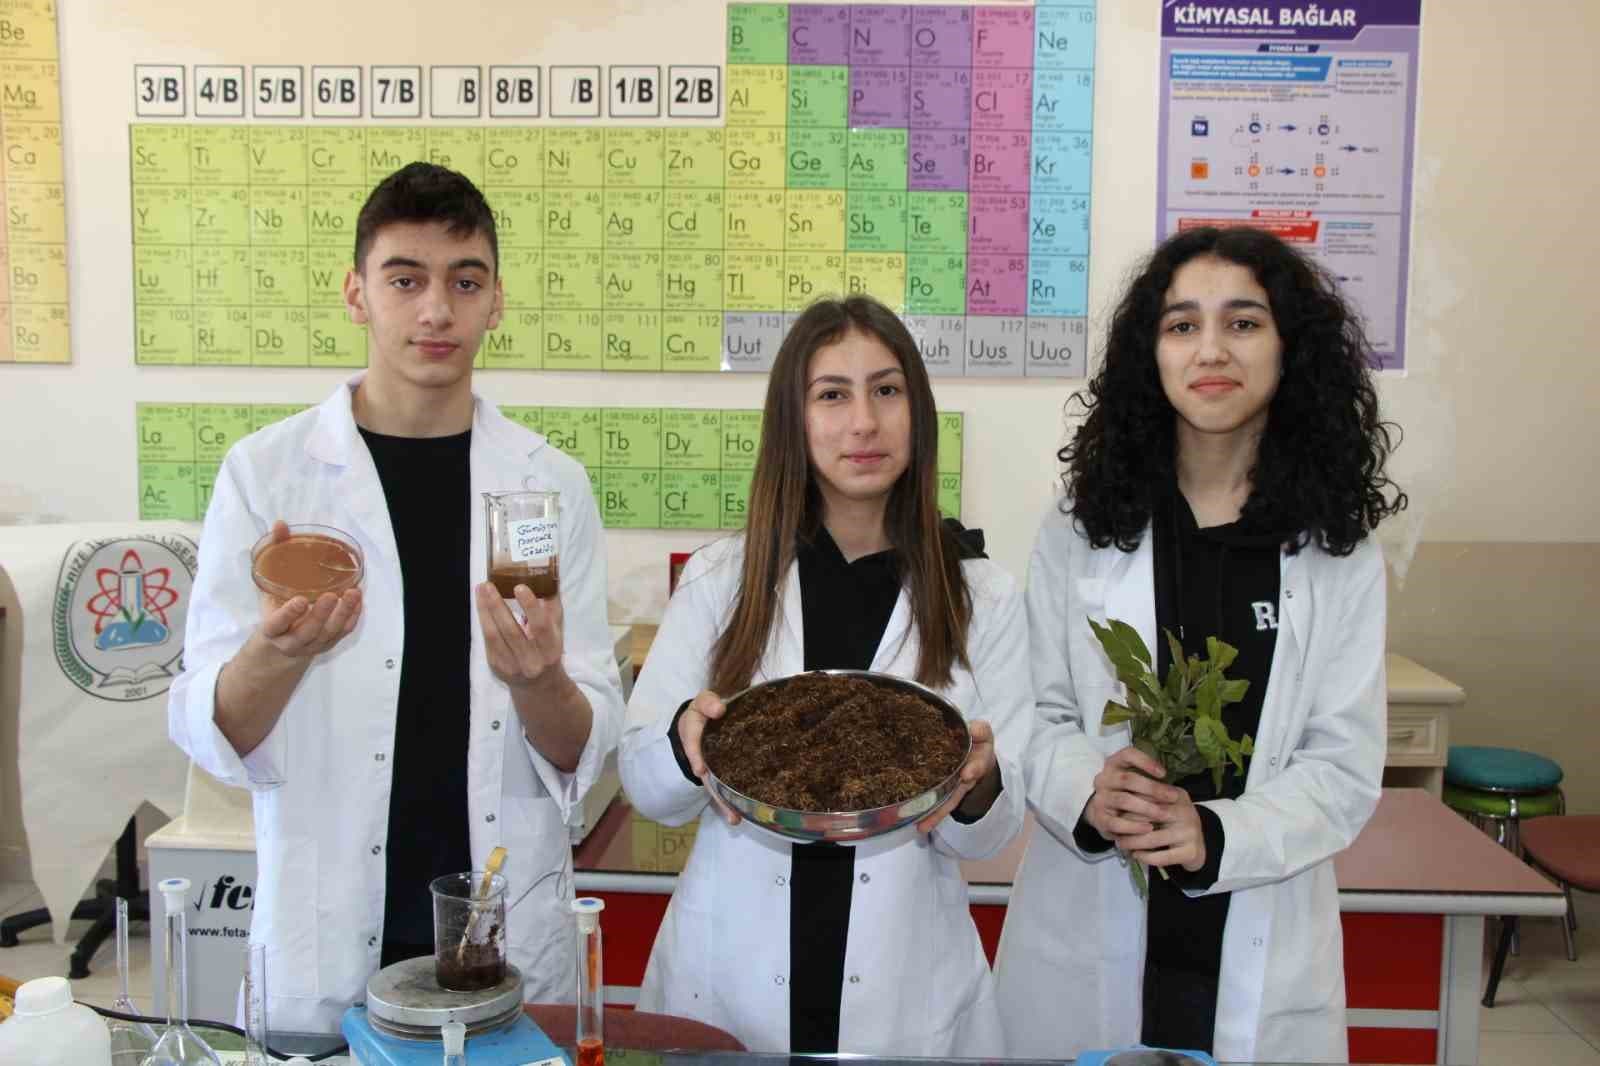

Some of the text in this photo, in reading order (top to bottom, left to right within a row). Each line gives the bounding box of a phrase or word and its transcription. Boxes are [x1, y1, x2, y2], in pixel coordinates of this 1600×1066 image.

[1174, 3, 1356, 26] KİMYASAL BAĞLAR
[0, 21, 24, 40] Be
[732, 27, 743, 44] B
[793, 27, 808, 47] C
[854, 28, 870, 46] N
[915, 29, 935, 47] O
[978, 30, 988, 48] F
[1039, 32, 1067, 50] Ne
[4, 85, 36, 106] Mg
[142, 78, 178, 102] 3/B
[200, 78, 238, 103] 4/B
[260, 79, 296, 103] 5/B
[318, 79, 355, 103] 6/B
[378, 79, 414, 103] 7/B
[497, 79, 533, 103] 8/B
[616, 78, 653, 102] 1/B
[675, 78, 713, 103] 2/B
[730, 89, 748, 107] Al
[792, 90, 807, 109] Si
[853, 90, 864, 110] P
[914, 91, 925, 110] S
[976, 92, 997, 112] Cl
[1036, 94, 1058, 112] Ar
[8, 146, 36, 167] Ca
[136, 147, 157, 167] Sc
[195, 148, 210, 167] Ti
[252, 148, 265, 165] V
[312, 149, 335, 167] Cr
[488, 149, 517, 170] Co
[549, 151, 569, 168] Ni
[608, 150, 636, 169] Cu
[669, 151, 693, 170] Zn
[729, 151, 760, 170] Ga
[790, 152, 821, 171] Ge
[850, 154, 874, 172] As
[913, 154, 935, 173] Se
[974, 155, 994, 174] Br
[1035, 157, 1055, 176] Kr
[10, 208, 28, 226] Sr
[137, 208, 149, 226] Y
[196, 208, 215, 227] Zr
[255, 209, 282, 228] Nb
[312, 211, 343, 229] Mo
[549, 211, 571, 230] Pd
[607, 212, 633, 236] Ag
[668, 212, 696, 231] Cd
[729, 214, 745, 231] In
[789, 214, 812, 232] Sn
[851, 214, 874, 233] Sb
[912, 216, 931, 234] Te
[1032, 218, 1056, 237] Xe
[14, 267, 38, 288] Ba
[139, 270, 159, 289] Lu
[197, 269, 217, 287] Hf
[255, 270, 274, 288] Ta
[312, 271, 332, 288] W
[548, 273, 564, 290] Pt
[606, 274, 632, 291] Au
[667, 274, 695, 297] Hg
[728, 274, 743, 293] Tl
[789, 275, 812, 294] Pb
[911, 277, 933, 296] Po
[970, 279, 990, 296] At
[1032, 280, 1055, 297] Rn
[16, 328, 39, 345] Ra
[140, 329, 156, 347] Lr
[198, 329, 215, 348] Rf
[256, 331, 283, 348] Db
[313, 331, 336, 353] Sg
[488, 334, 512, 350] Mt
[548, 335, 571, 352] Ds
[667, 335, 695, 353] Cn
[728, 337, 760, 354] Uut
[607, 335, 631, 359] Rg
[970, 341, 1007, 359] Uus
[1030, 342, 1071, 360] Uuo
[142, 426, 161, 443] La
[199, 426, 225, 444] Ce
[606, 432, 629, 450] Tb
[666, 432, 690, 453] Dy
[726, 433, 754, 452] Ho
[144, 485, 166, 502] Ac
[606, 491, 628, 509] Bk
[665, 492, 688, 511] Cf
[725, 493, 744, 512] Es
[1251, 601, 1279, 630] R
[124, 688, 147, 697] 2001
